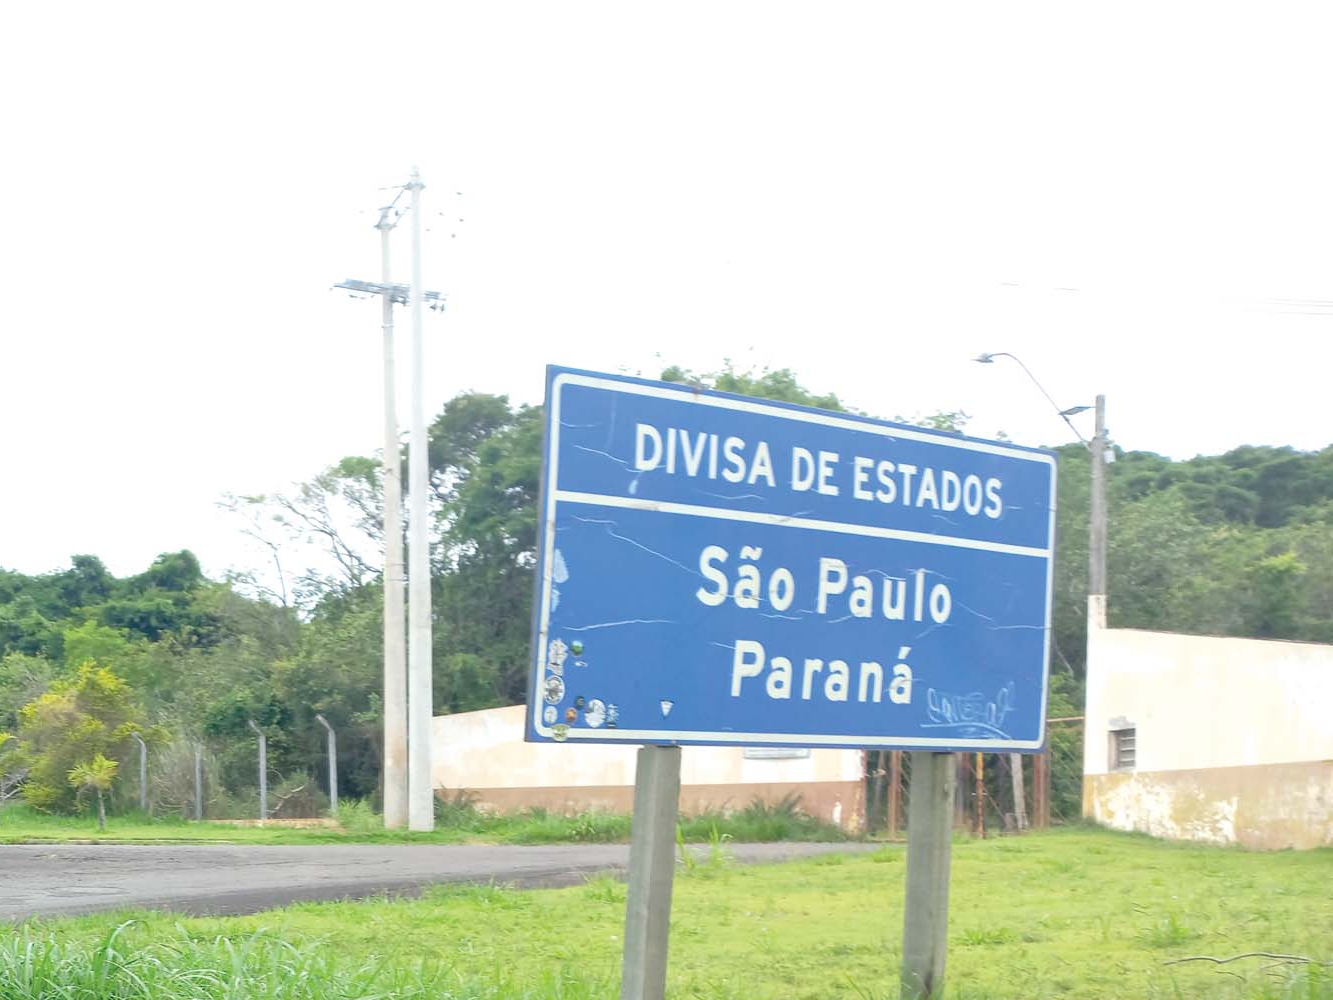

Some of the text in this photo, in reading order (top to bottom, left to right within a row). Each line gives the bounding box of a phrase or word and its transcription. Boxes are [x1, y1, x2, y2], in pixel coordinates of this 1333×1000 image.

[635, 423, 1004, 519] DIVISA DE ESTADOS
[695, 545, 952, 624] São Paulo
[730, 640, 912, 704] Paraná
